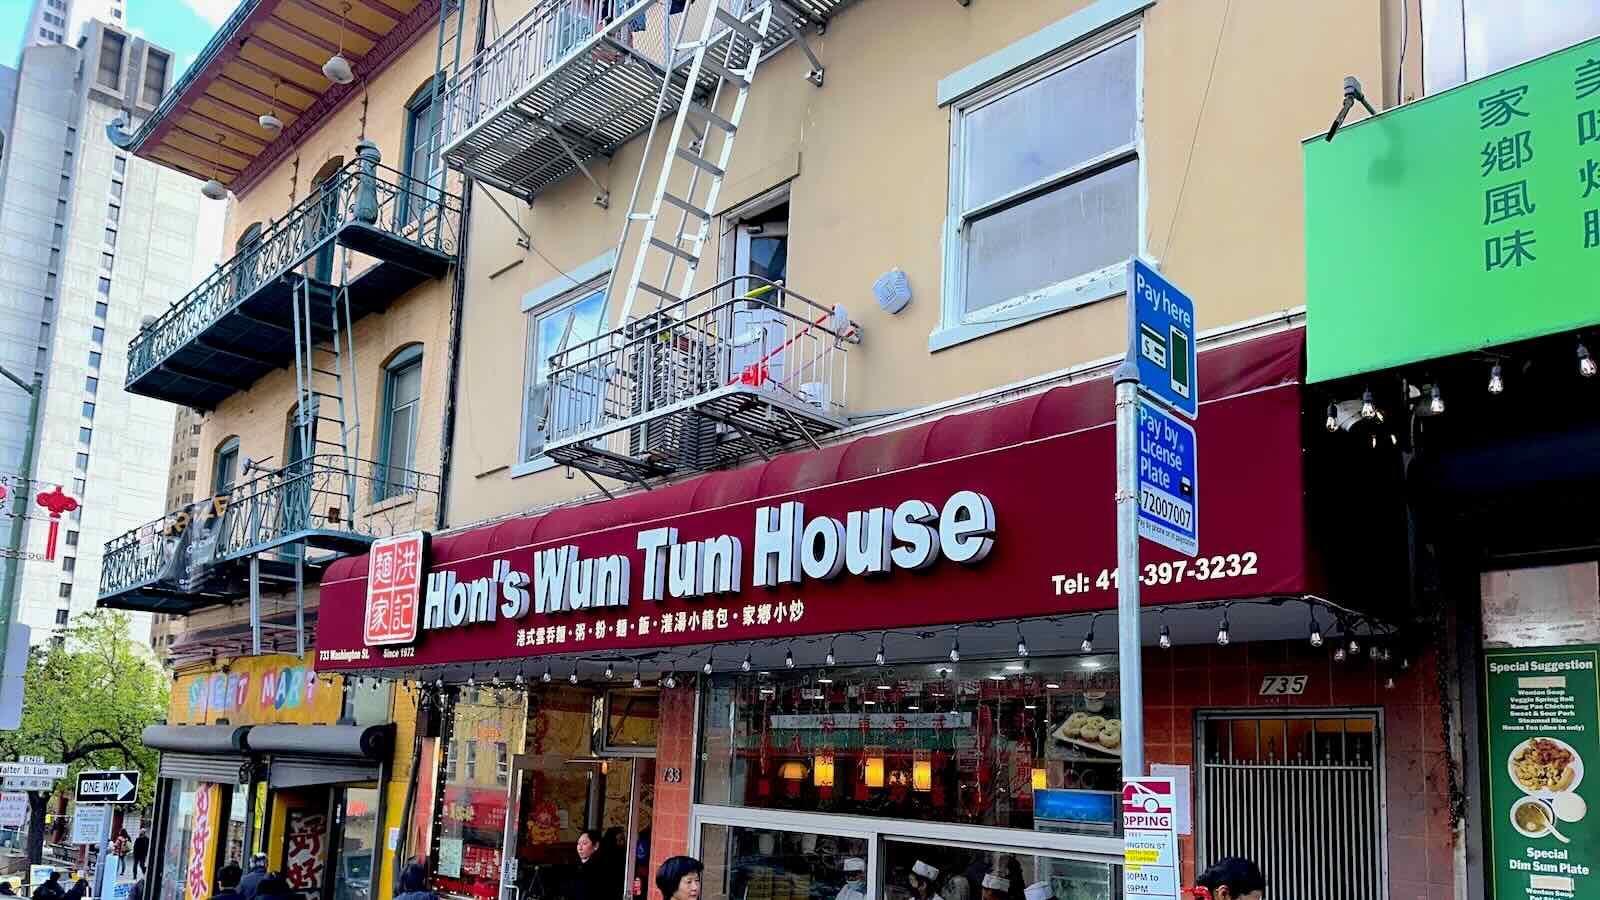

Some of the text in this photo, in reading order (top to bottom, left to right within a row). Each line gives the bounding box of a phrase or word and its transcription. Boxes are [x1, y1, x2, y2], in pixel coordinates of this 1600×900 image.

[1136, 271, 1191, 329] Pay here
[1140, 406, 1179, 450] Pay by
[1140, 431, 1183, 472] License
[1140, 455, 1171, 489] Plate
[1142, 490, 1192, 530] 72007007
[424, 490, 997, 630] Hon's Wun Tun House
[1051, 551, 1258, 596] Tel: 41-397-3232
[319, 650, 329, 661] 733
[330, 649, 361, 662] Washington
[383, 647, 415, 658] Since 1972
[1489, 659, 1594, 674] Special Suggestion
[1262, 675, 1306, 694] 735
[662, 767, 681, 782] 733
[83, 781, 119, 793] ONE WAY
[1526, 847, 1568, 860] Special
[1509, 859, 1590, 875] Dim Sum Plate
[1150, 873, 1159, 882] to
